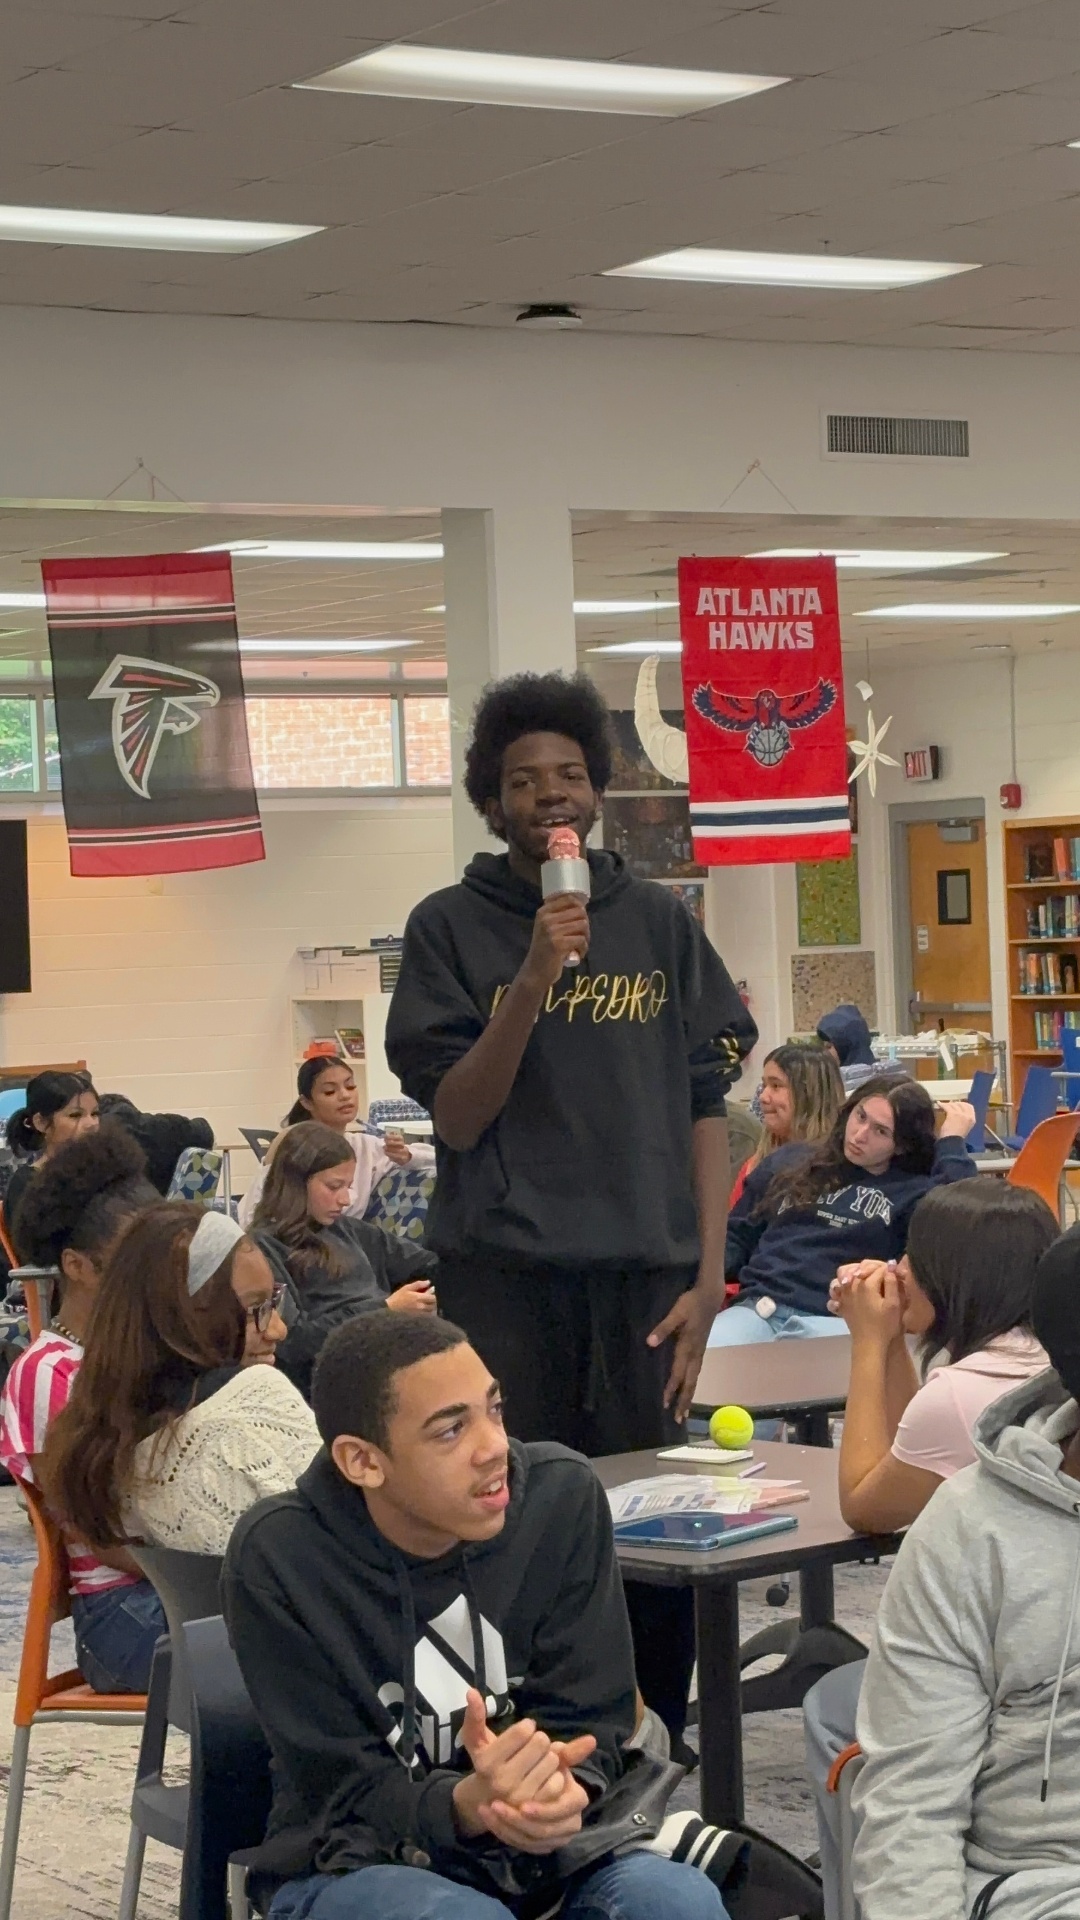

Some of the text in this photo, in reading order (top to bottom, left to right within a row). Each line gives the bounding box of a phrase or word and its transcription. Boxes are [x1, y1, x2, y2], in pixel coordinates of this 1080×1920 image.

[695, 587, 823, 616] ATLANTA
[708, 621, 814, 650] HAWKS
[904, 750, 928, 779] EXIT
